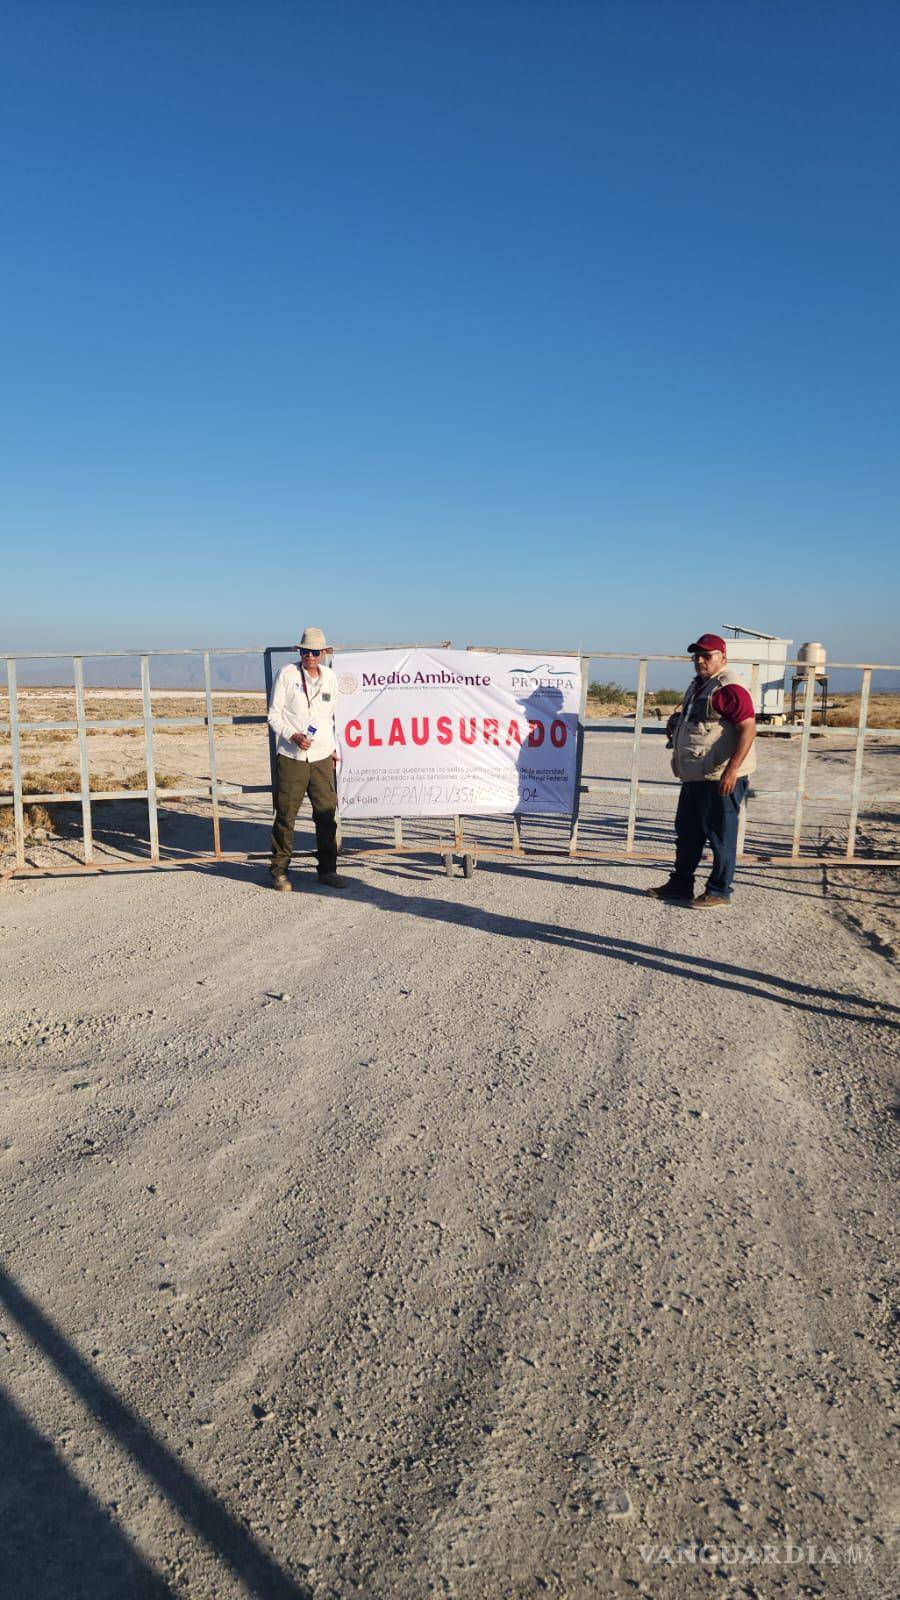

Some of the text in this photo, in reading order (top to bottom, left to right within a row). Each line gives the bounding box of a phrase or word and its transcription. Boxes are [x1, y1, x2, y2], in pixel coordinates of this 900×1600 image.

[362, 670, 491, 686] Medio Ambiente
[511, 677, 574, 689] PROFEPA
[345, 716, 568, 748] CLAUSURADO
[360, 768, 386, 777] persona
[357, 795, 377, 804] Folio
